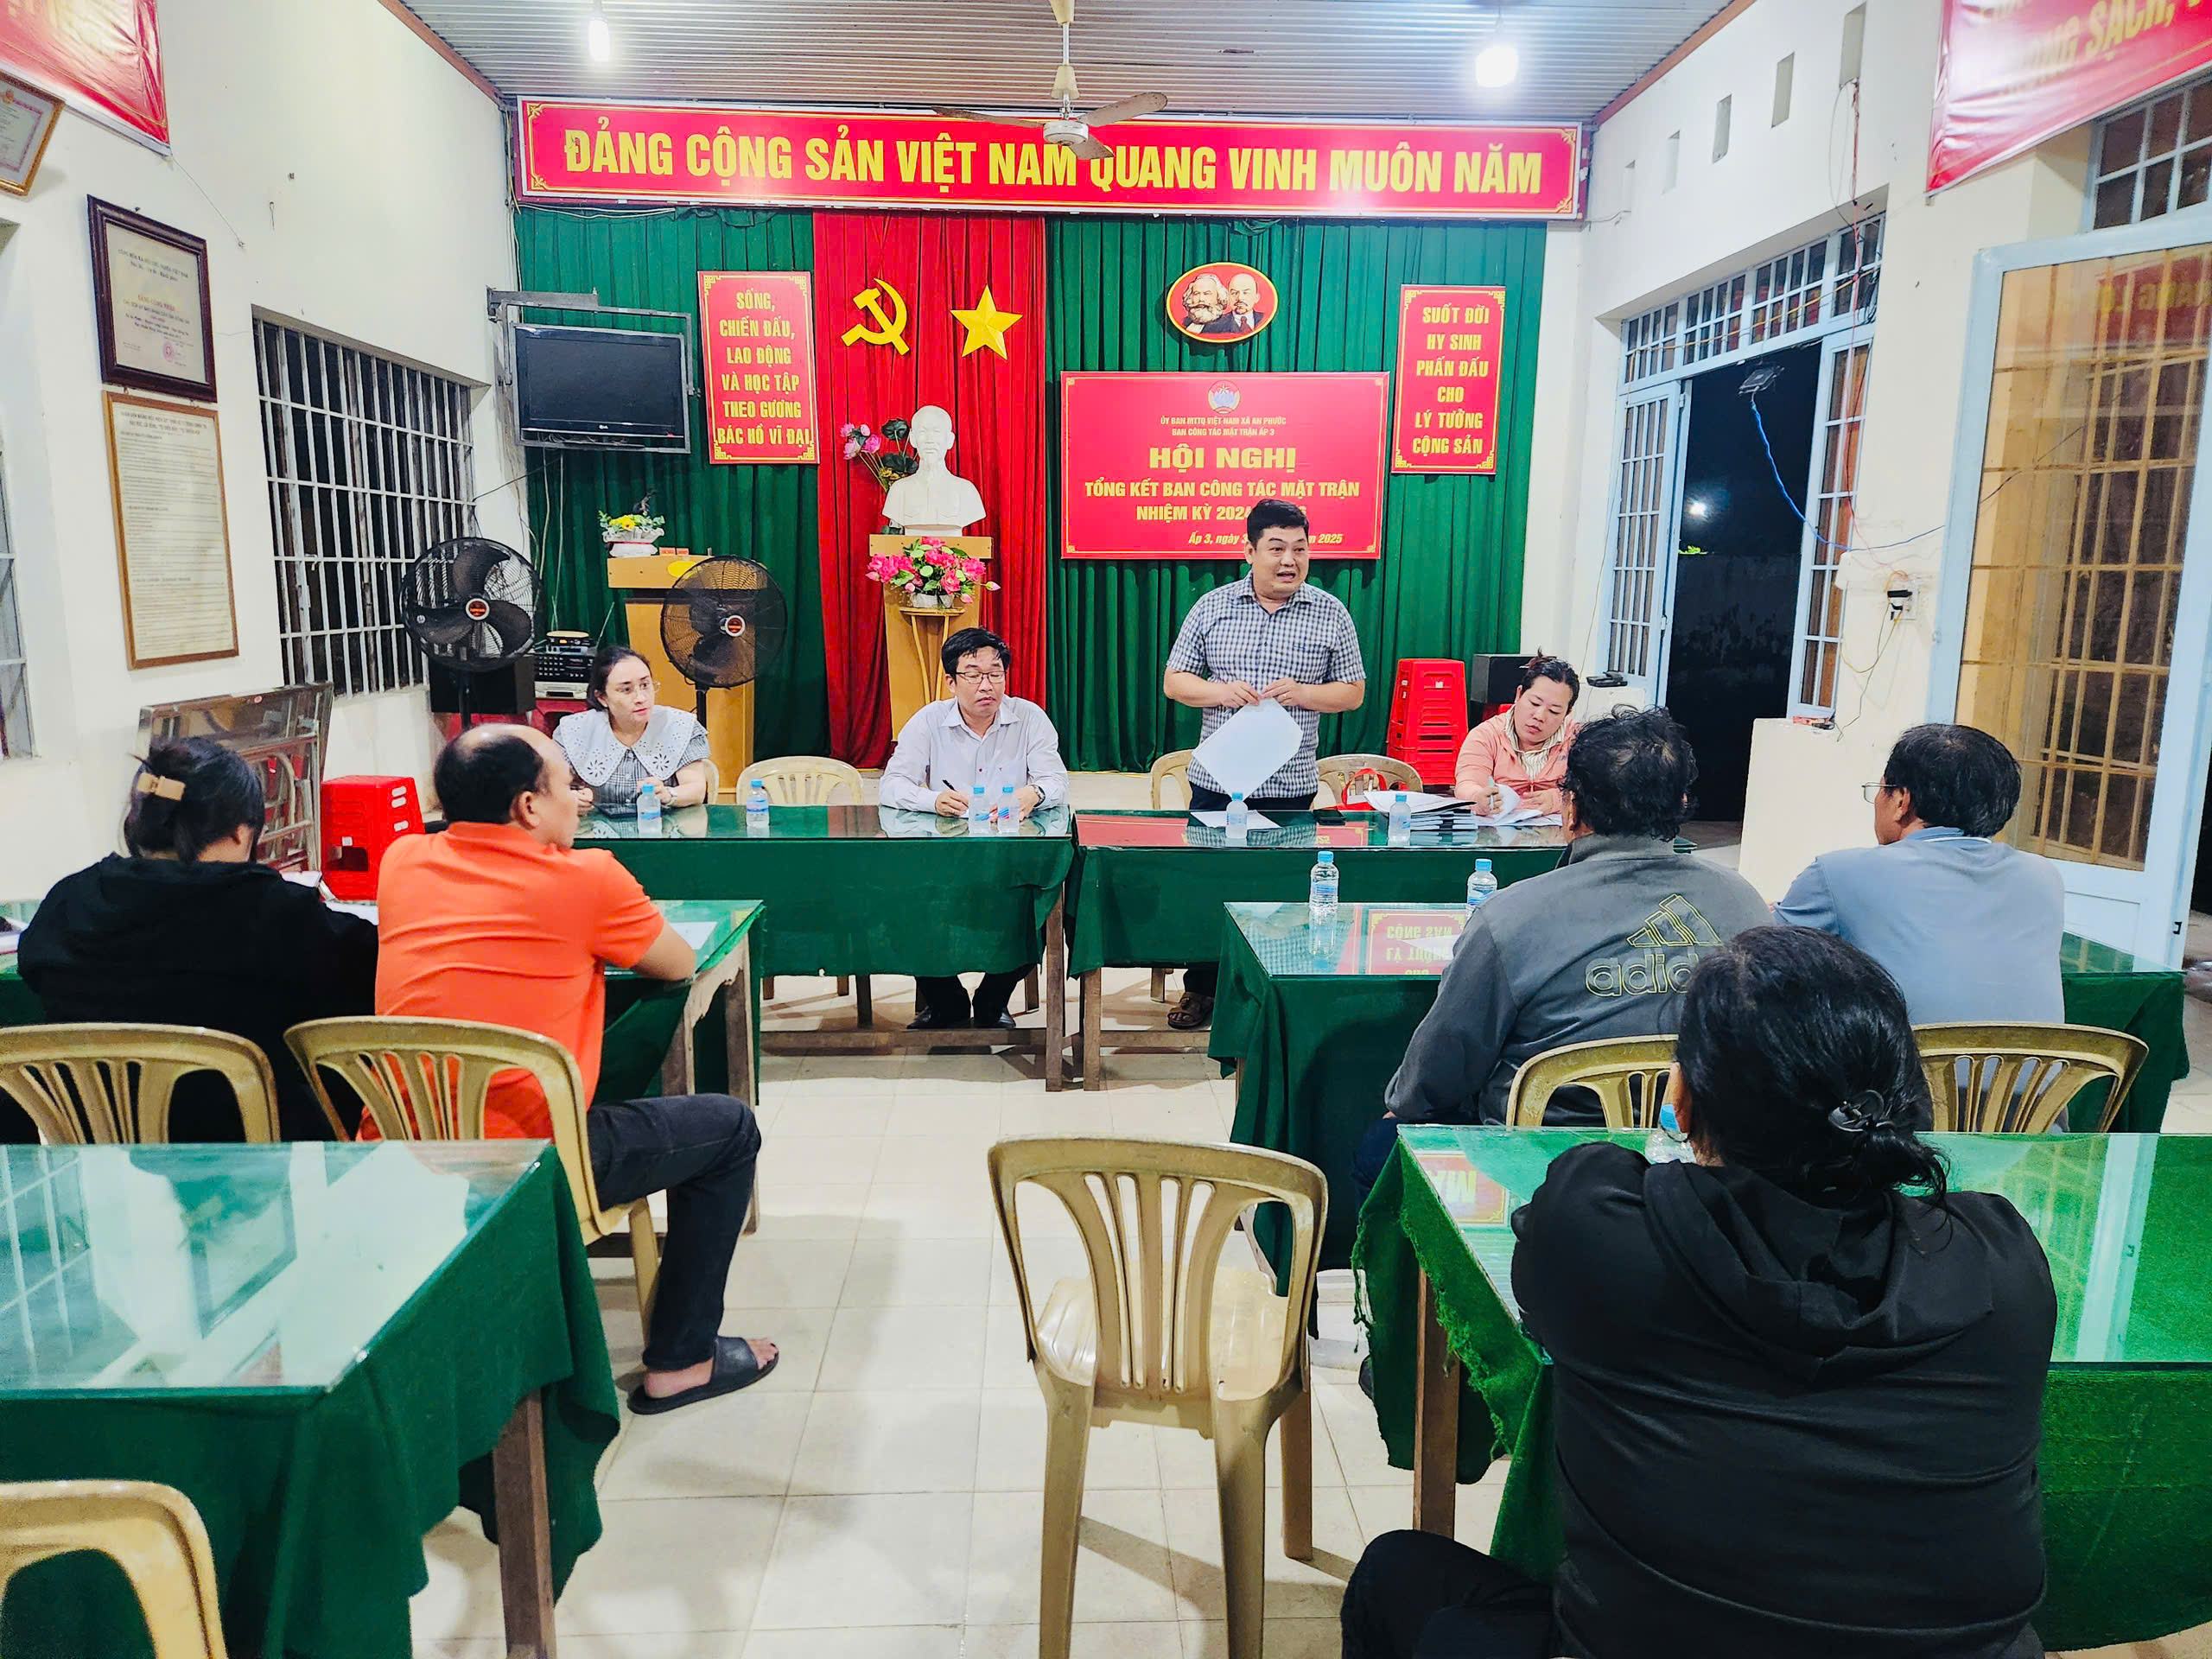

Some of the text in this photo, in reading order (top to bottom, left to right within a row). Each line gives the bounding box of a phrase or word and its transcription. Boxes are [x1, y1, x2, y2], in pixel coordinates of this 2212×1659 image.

[564, 116, 1542, 194] ĐẢNG CỘNG SẢN VIỆT NAM QUANG VINH MUÔN NĂM
[736, 288, 775, 311] SỐNG,
[1422, 302, 1490, 324] SUỐT ĐỜI
[719, 315, 795, 340] CHIẾN ĐẤU,
[1427, 334, 1482, 351] HY SINH
[726, 345, 791, 367] LAO ĐỘNG
[1416, 356, 1489, 378] PHẤN ĐẤU
[721, 372, 799, 395] VÀ HỌC TẬP
[1438, 386, 1465, 403] CHO
[722, 399, 802, 418] THEO GƯƠNG
[1414, 408, 1484, 429] LÝ TƯỞNG
[1188, 427, 1207, 436] CÔNG
[1208, 427, 1222, 436] TÁC
[1223, 427, 1238, 437] MẶT
[1240, 427, 1258, 437] TRẬN
[1207, 416, 1222, 426] VIỆT
[1263, 416, 1286, 425] PHƯỚC
[717, 423, 810, 448] BÁC HỒ VĨ ĐẠI
[1412, 435, 1484, 456] CỘNG SẢN
[1150, 442, 1296, 473] HỘI NGHỊ
[1085, 477, 1360, 499] TỔNG KẾT BAN CÔNG TÁC MẶT TRẬN
[1136, 503, 1187, 523] NHIỆM
[1192, 504, 1212, 520] KỲ
[1205, 534, 1214, 546] 3,
[1215, 533, 1239, 547] ngày
[1319, 534, 1343, 544] 2025
[1586, 948, 1700, 997] adid
